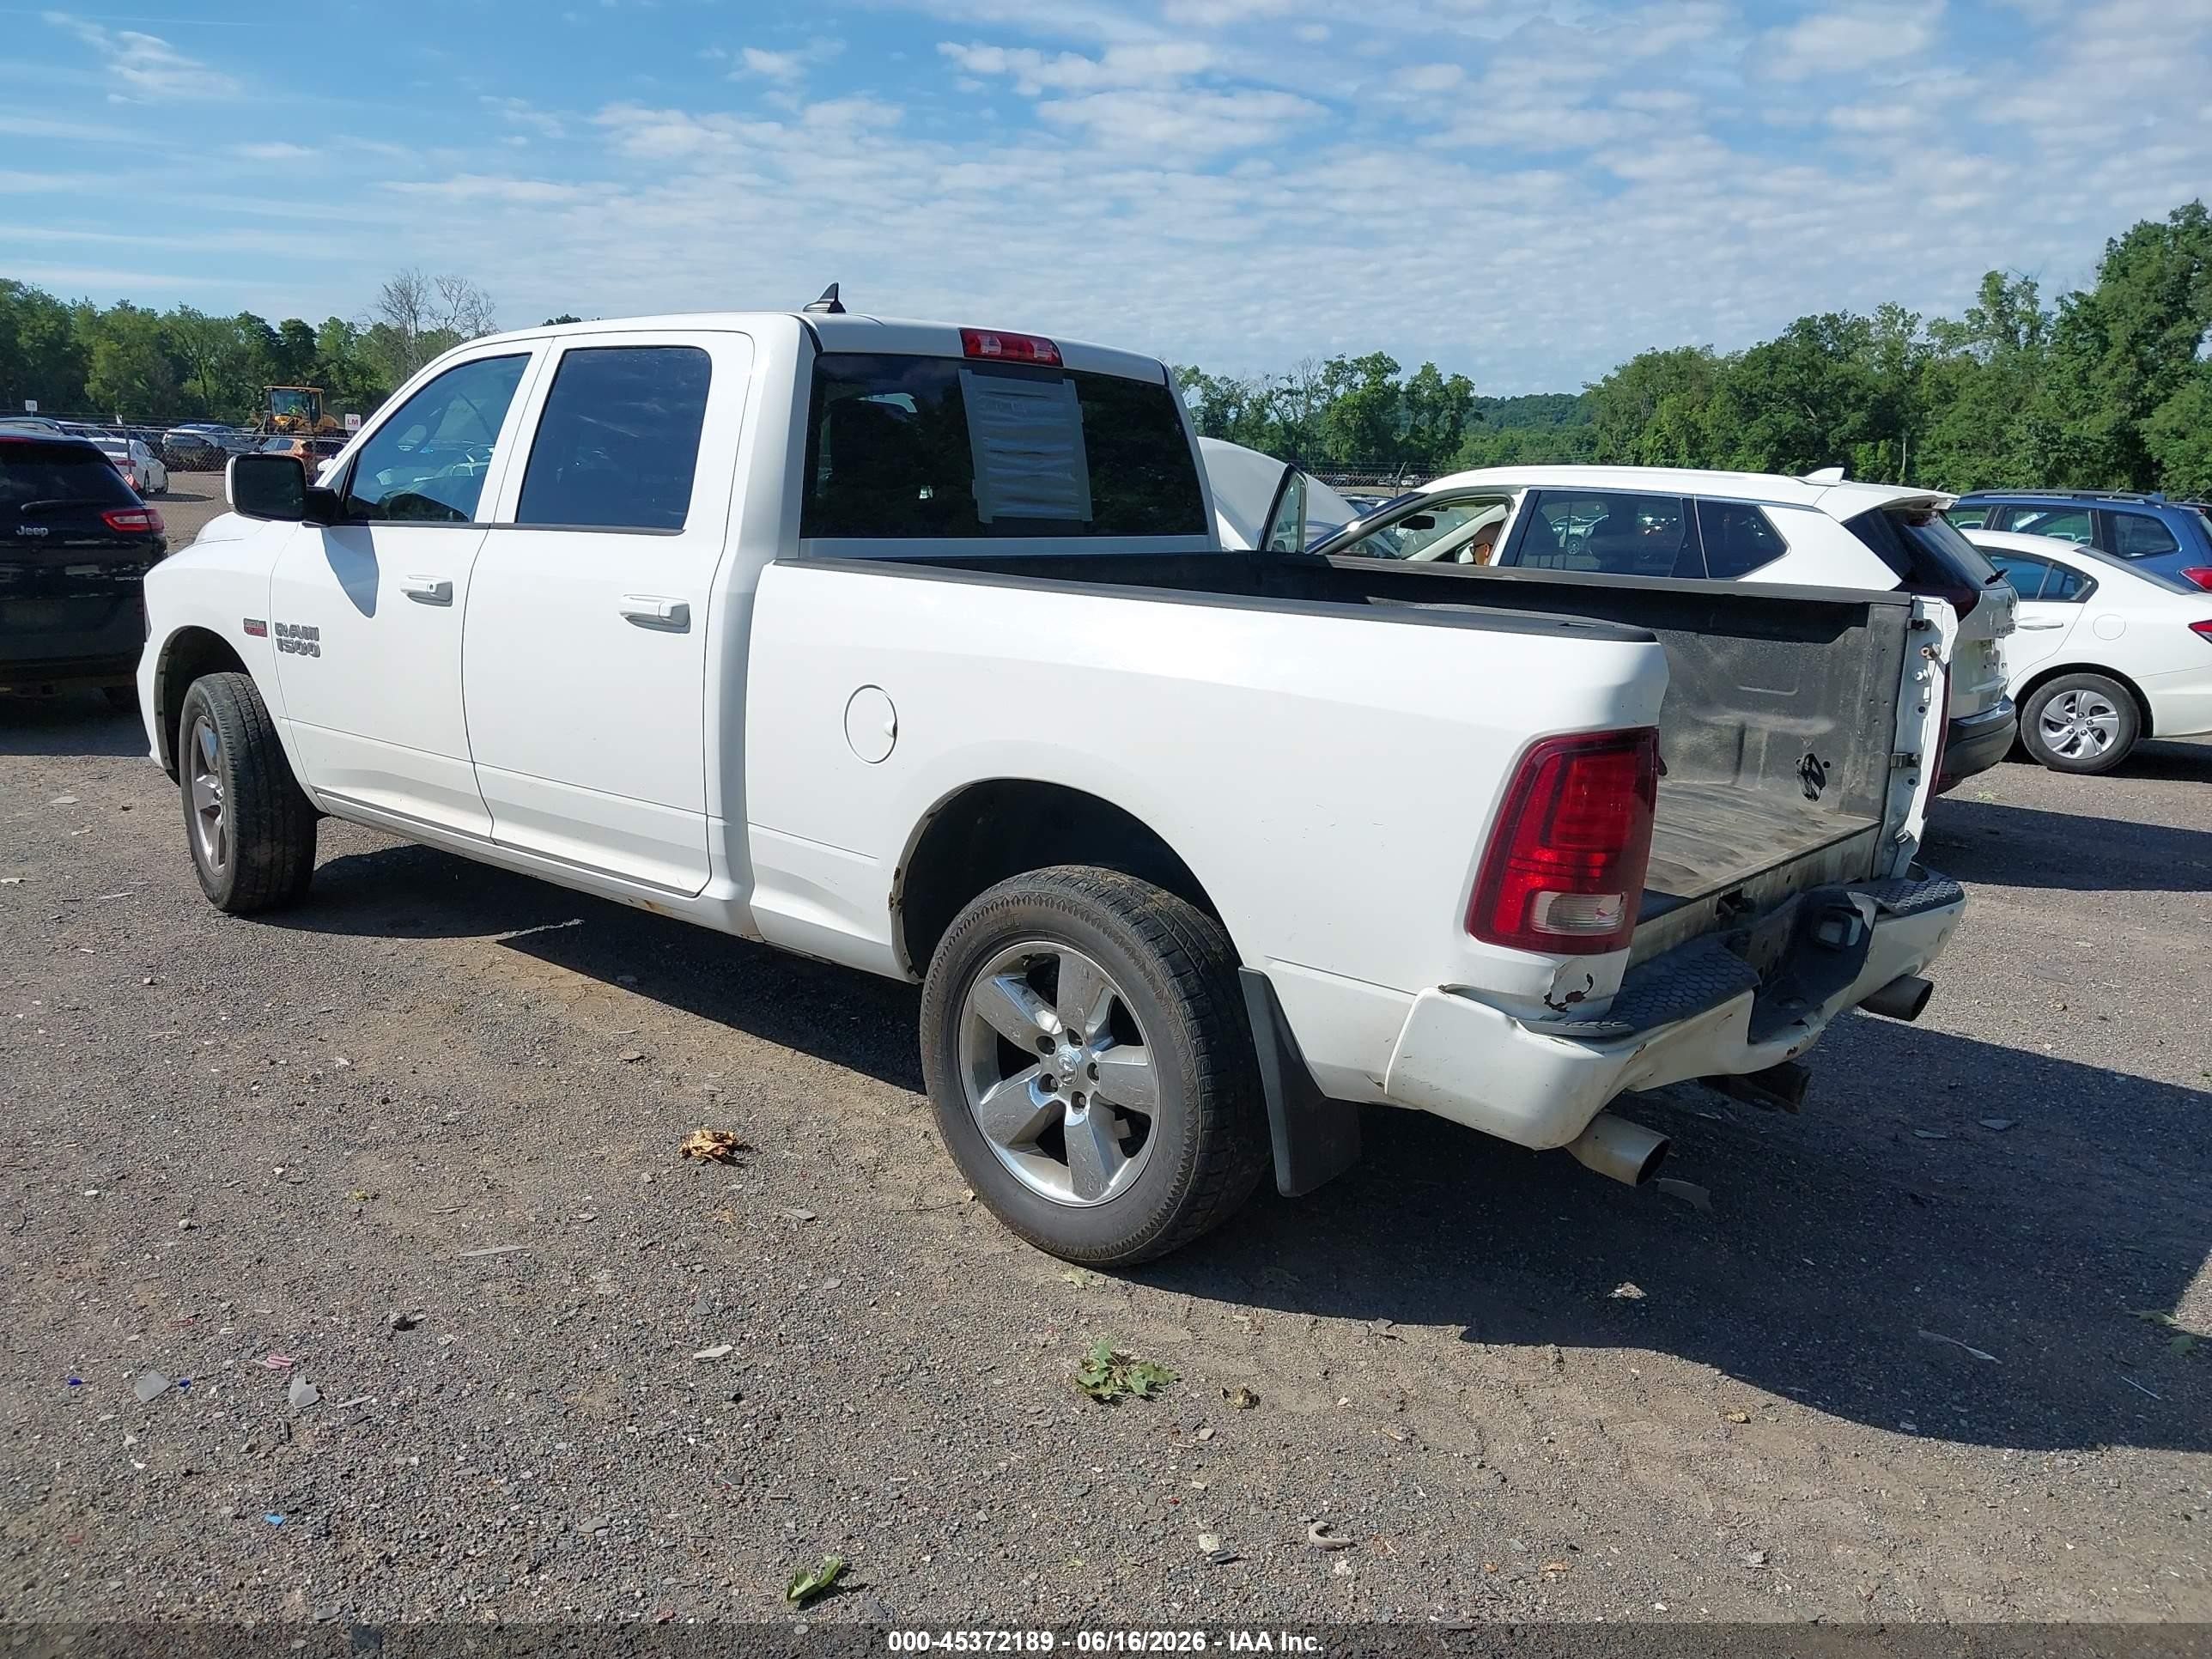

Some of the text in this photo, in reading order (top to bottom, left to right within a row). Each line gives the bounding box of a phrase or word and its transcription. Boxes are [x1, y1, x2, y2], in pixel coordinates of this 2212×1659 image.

[15, 526, 49, 537] Jeep
[274, 623, 319, 641] RAM
[276, 638, 321, 658] 1500
